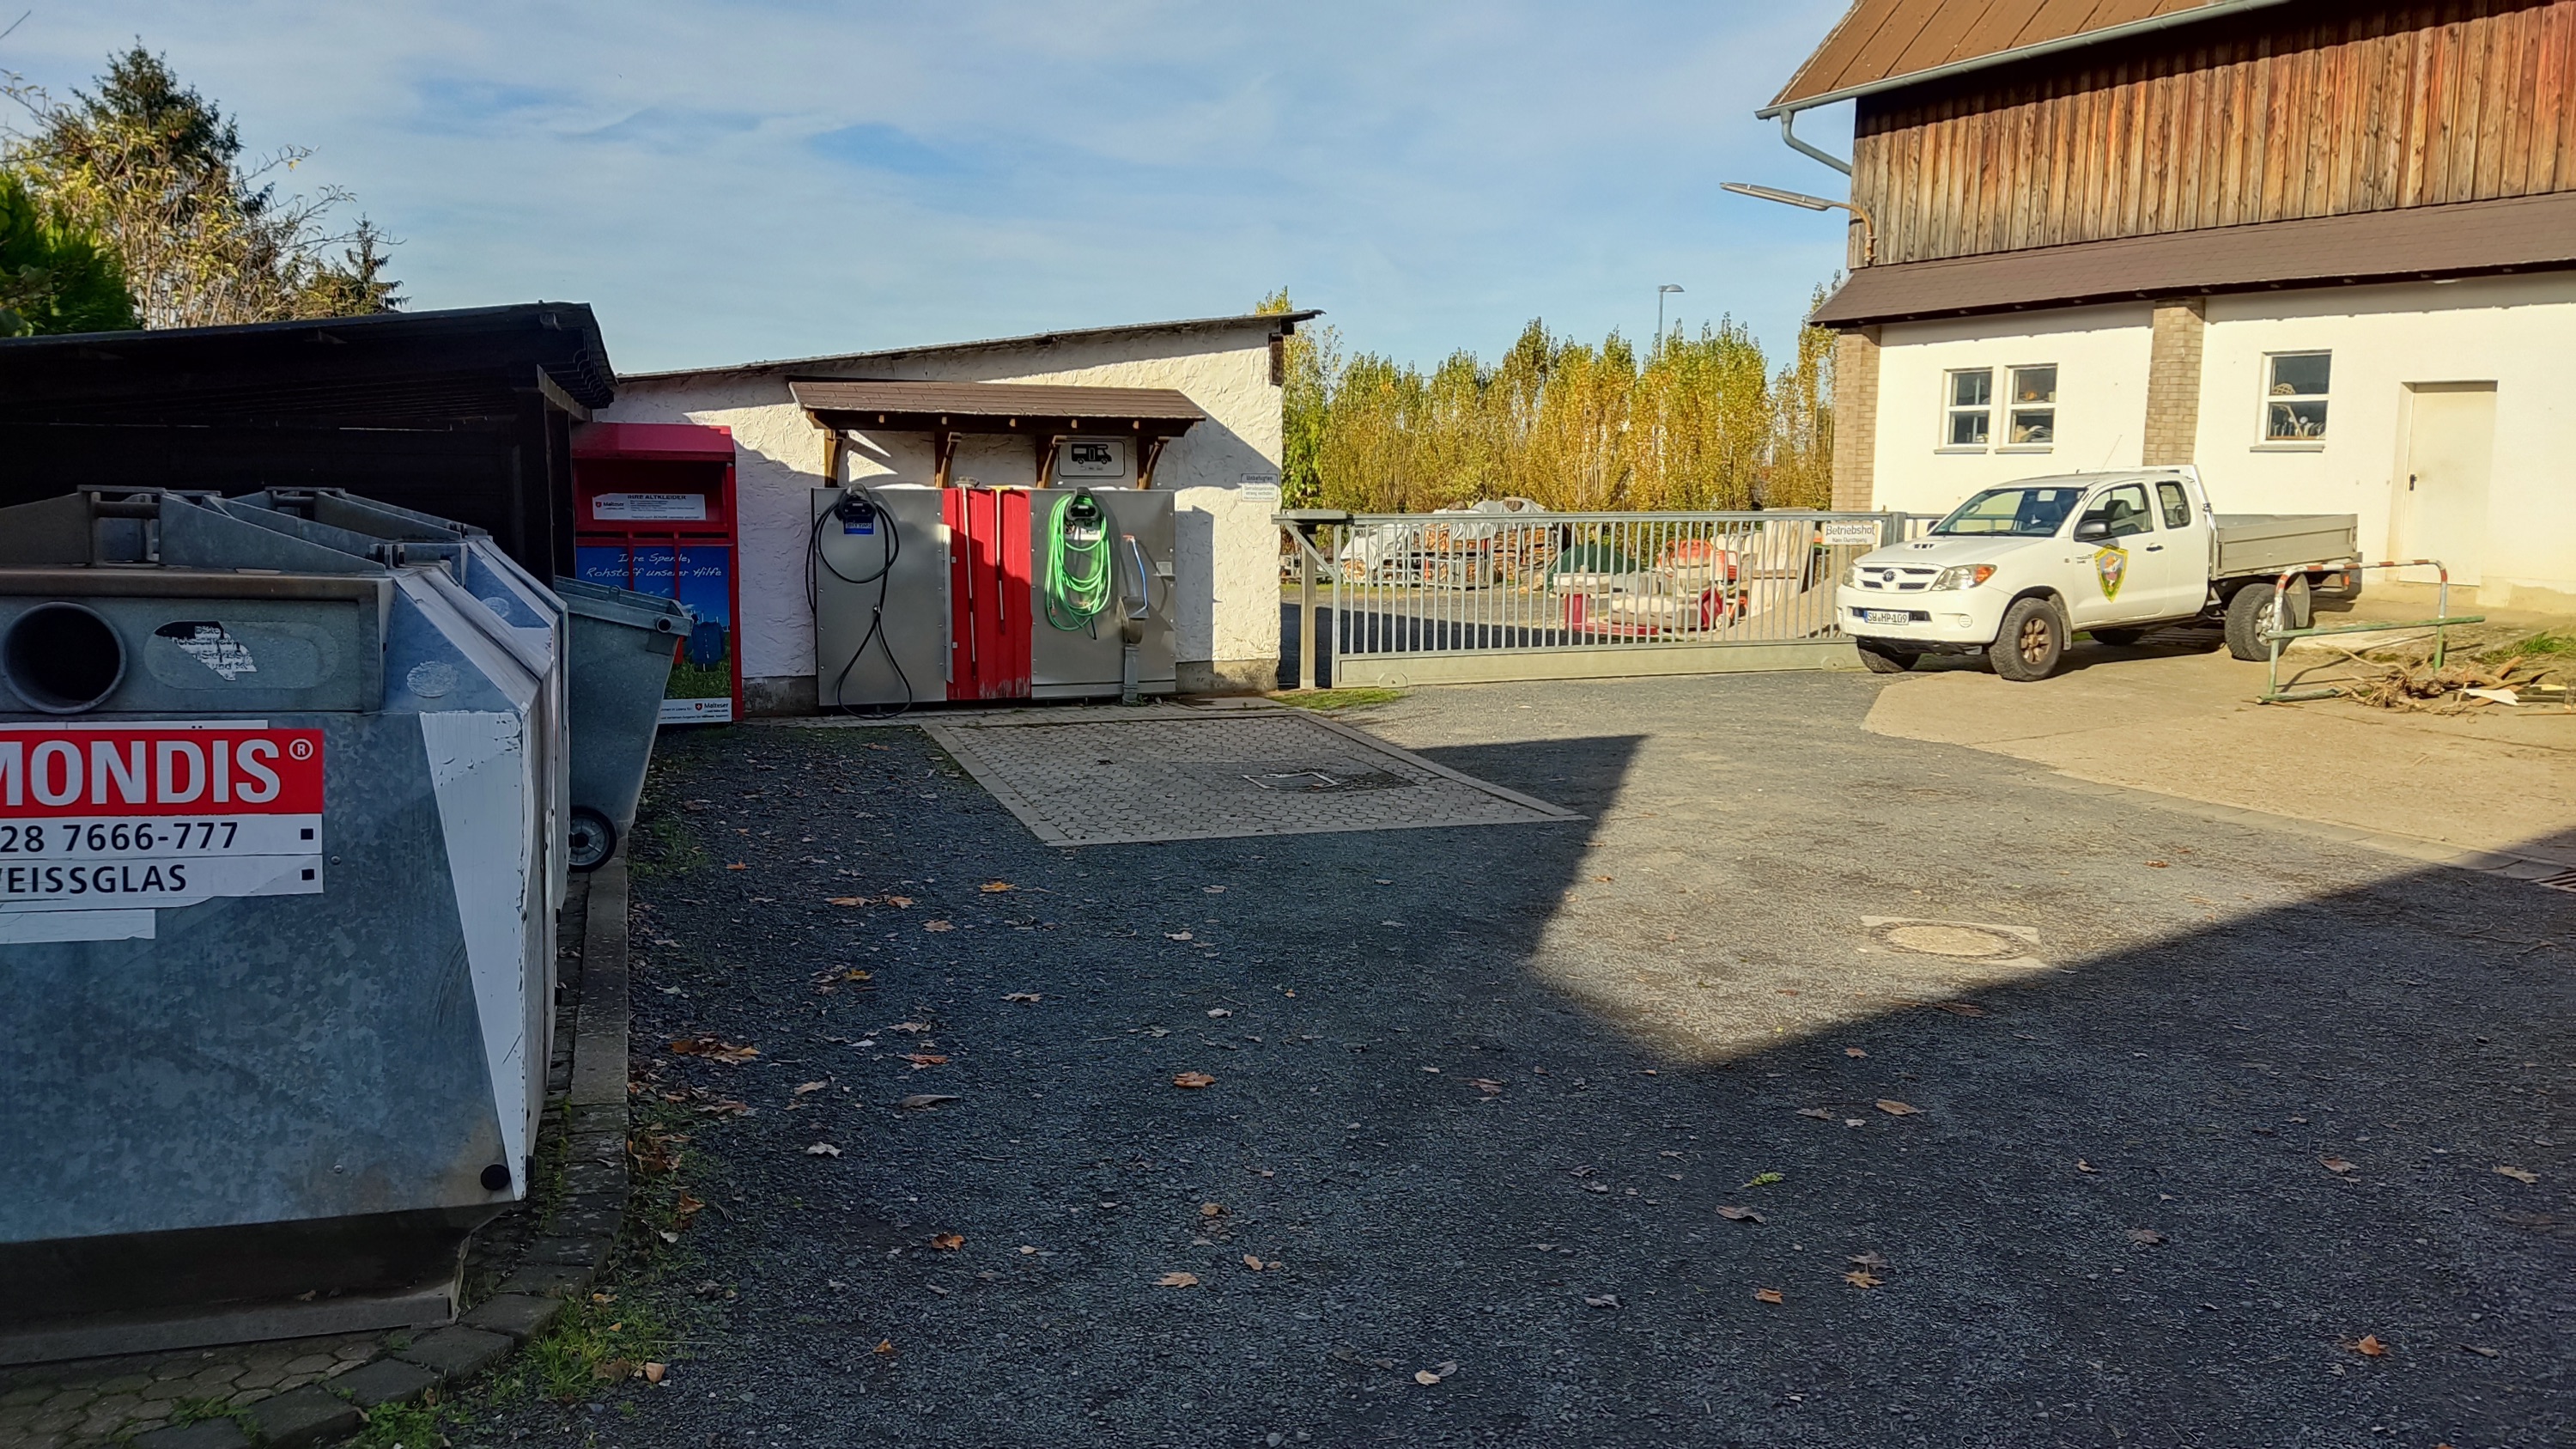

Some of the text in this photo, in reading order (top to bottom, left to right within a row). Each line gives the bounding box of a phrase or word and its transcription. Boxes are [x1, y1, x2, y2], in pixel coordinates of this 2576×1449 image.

[1826, 524, 1875, 536] Betriebshof
[617, 553, 645, 563] Ire
[692, 566, 722, 578] Hilfe
[62, 821, 239, 852] 7666-777
[0, 864, 187, 895] EISSGLAS
